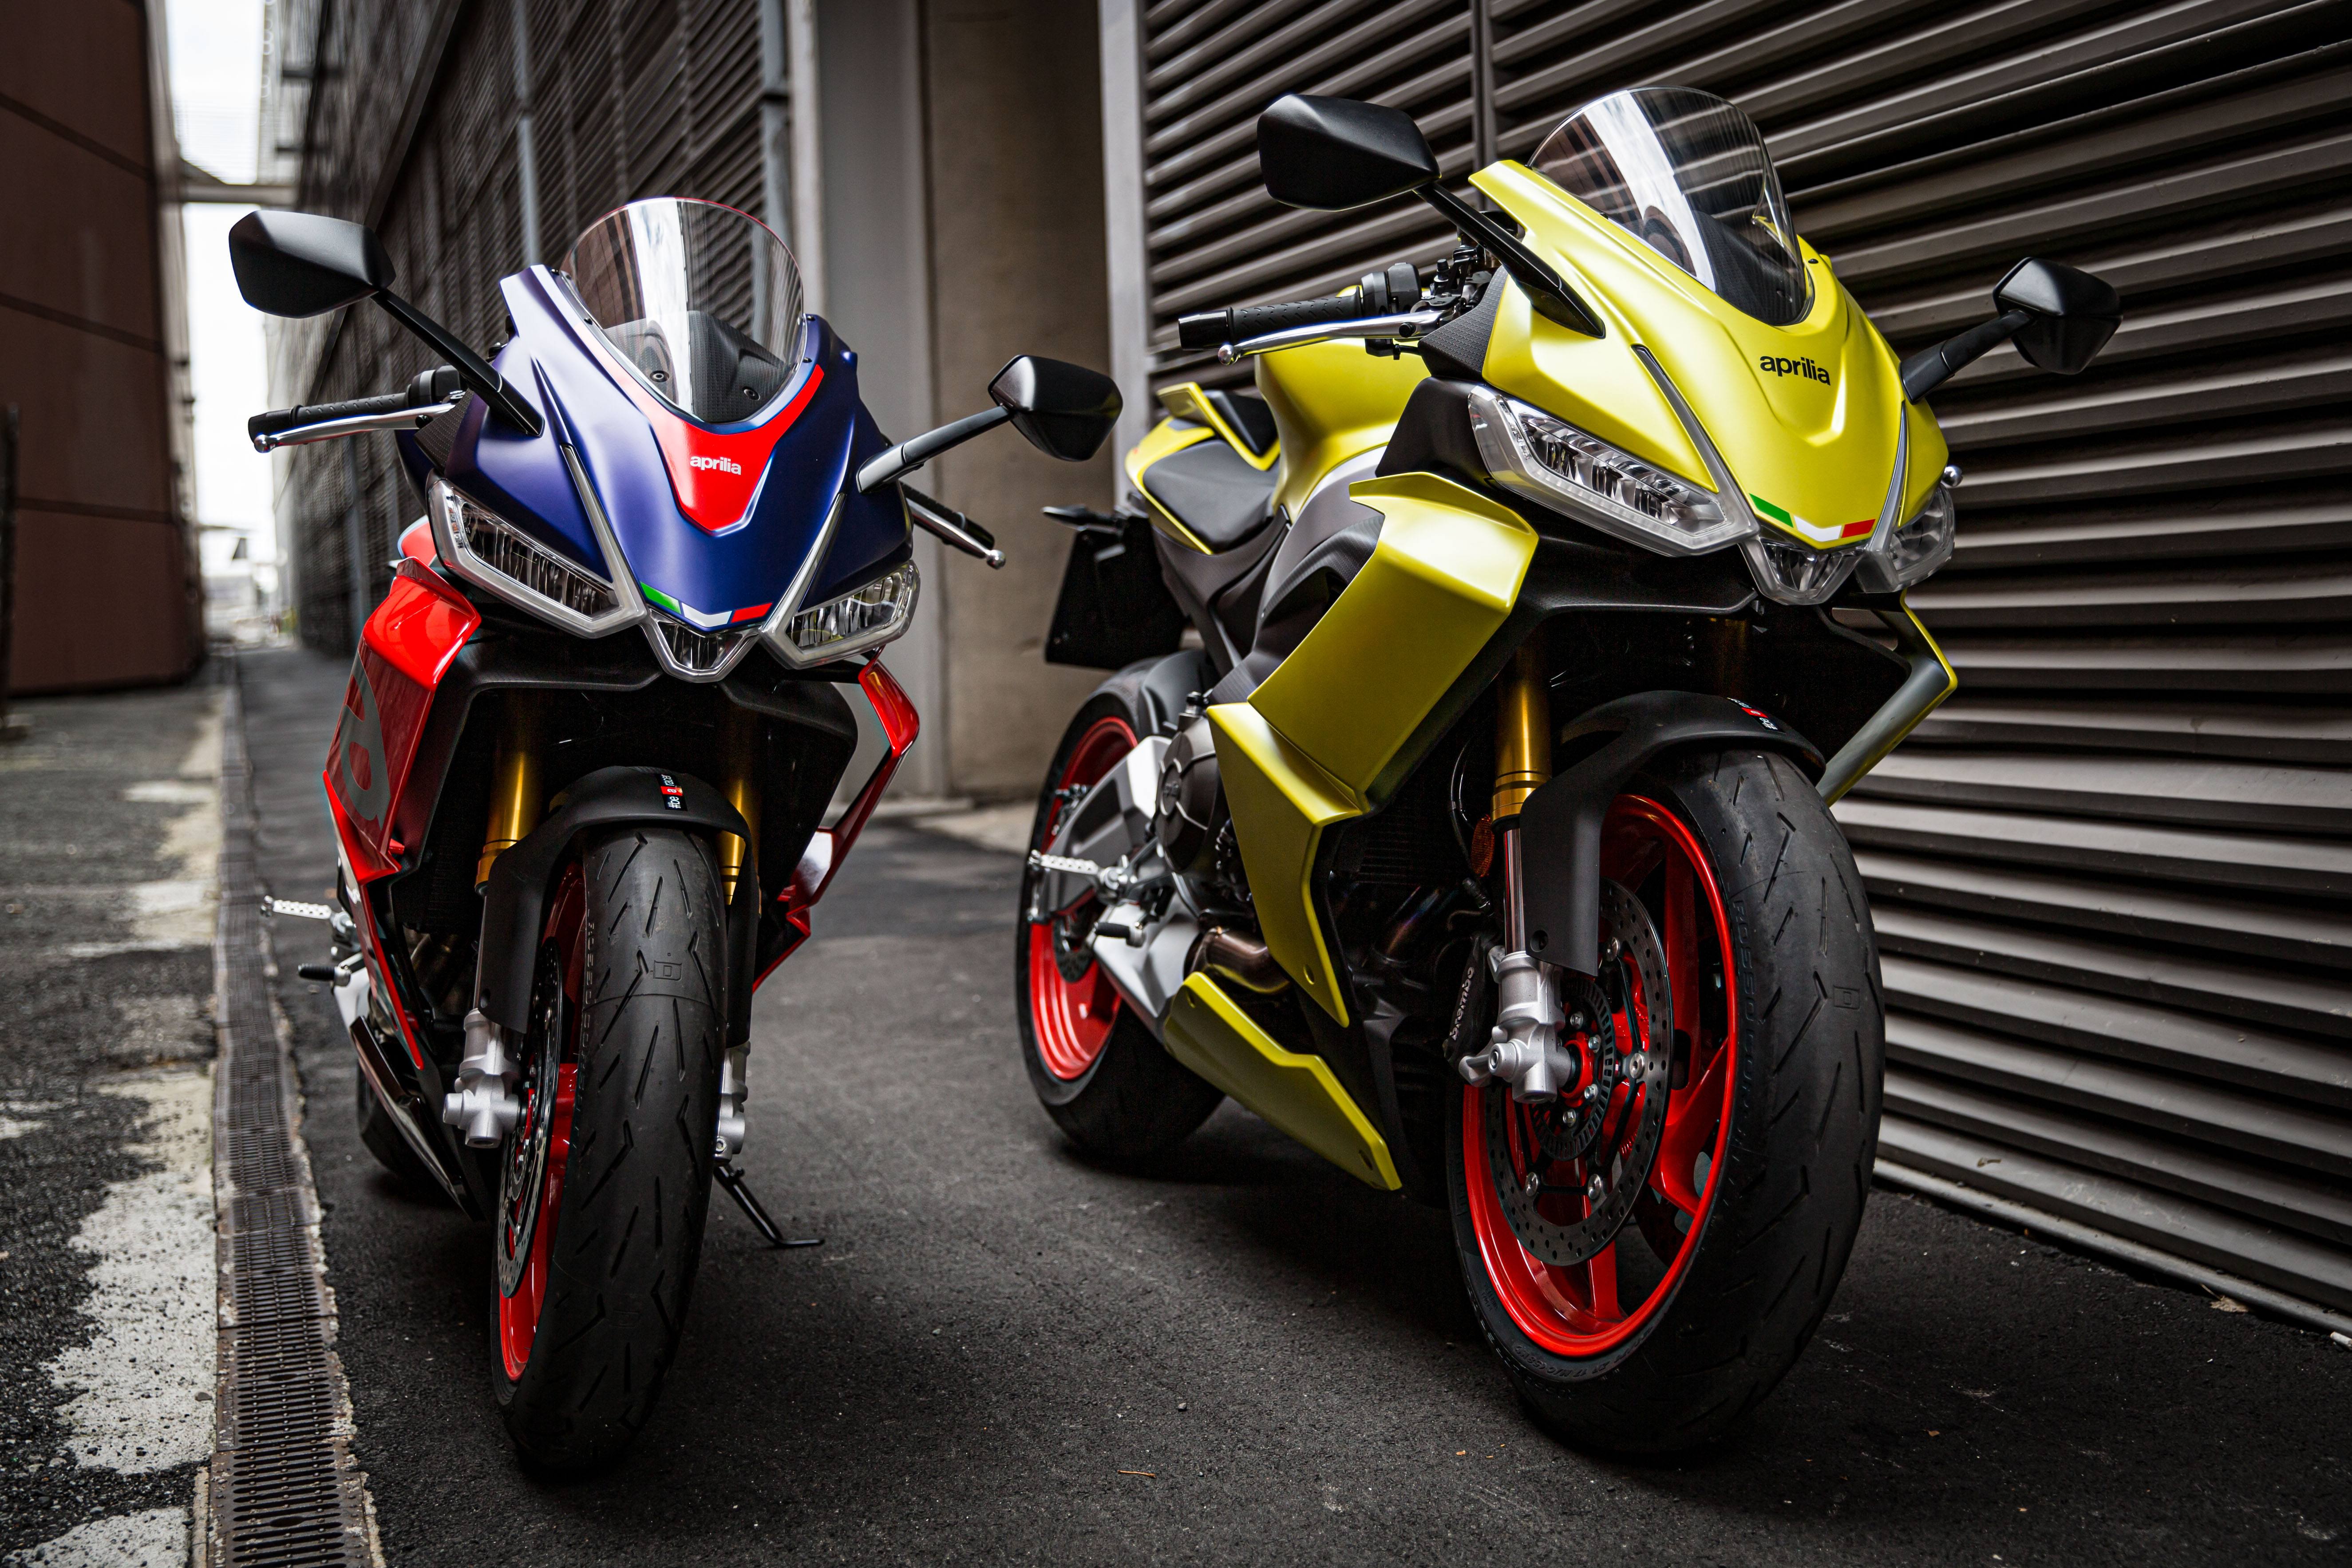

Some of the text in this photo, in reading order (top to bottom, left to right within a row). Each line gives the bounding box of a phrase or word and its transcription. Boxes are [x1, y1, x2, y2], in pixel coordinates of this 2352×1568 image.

[1759, 356, 1831, 386] aprilia
[690, 456, 741, 475] aprilia
[667, 796, 681, 808] #be
[1449, 967, 1474, 1041] brembo
